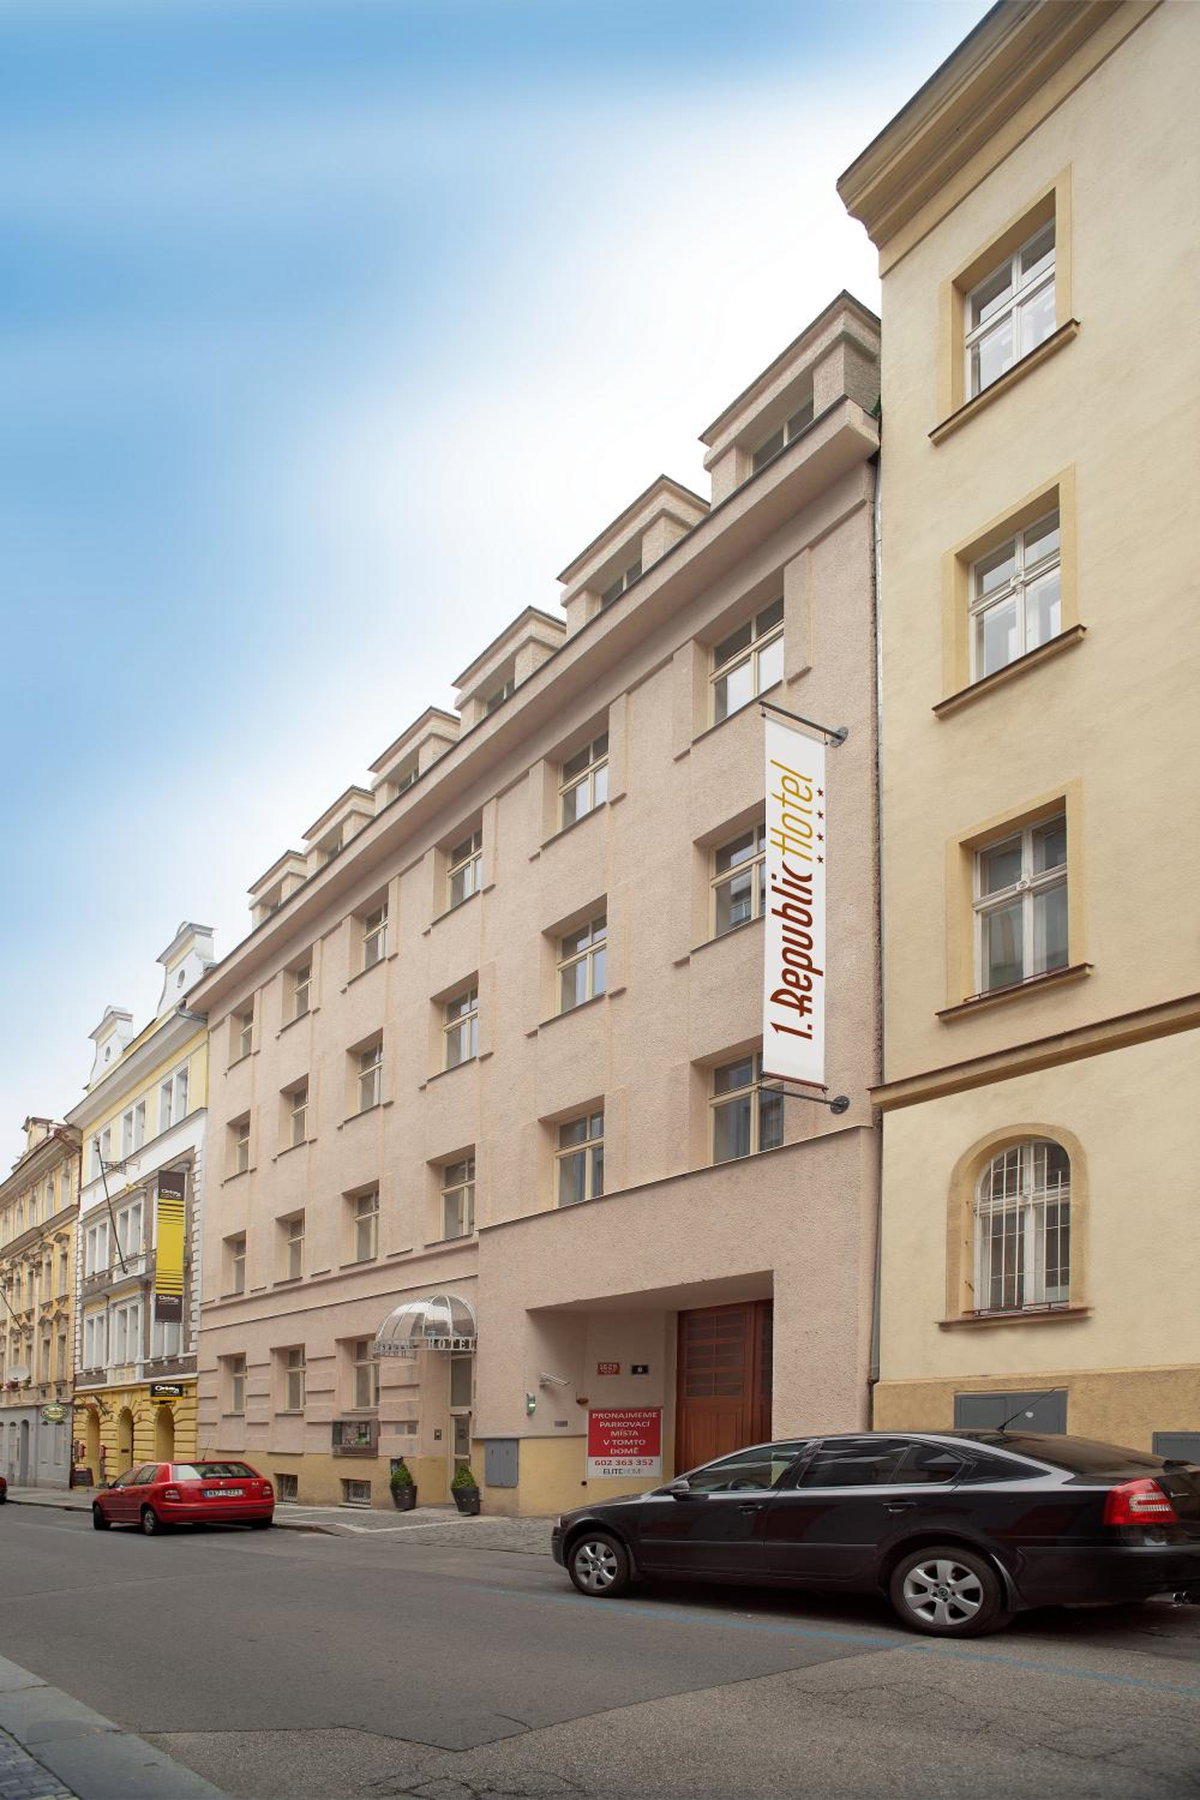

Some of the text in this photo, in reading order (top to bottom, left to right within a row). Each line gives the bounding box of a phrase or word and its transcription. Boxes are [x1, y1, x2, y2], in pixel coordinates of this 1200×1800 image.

[769, 758, 824, 1040] 1. Republic Hotel
[599, 1420, 650, 1428] PARKOVACÍ
[610, 1429, 639, 1437] MÍSTA
